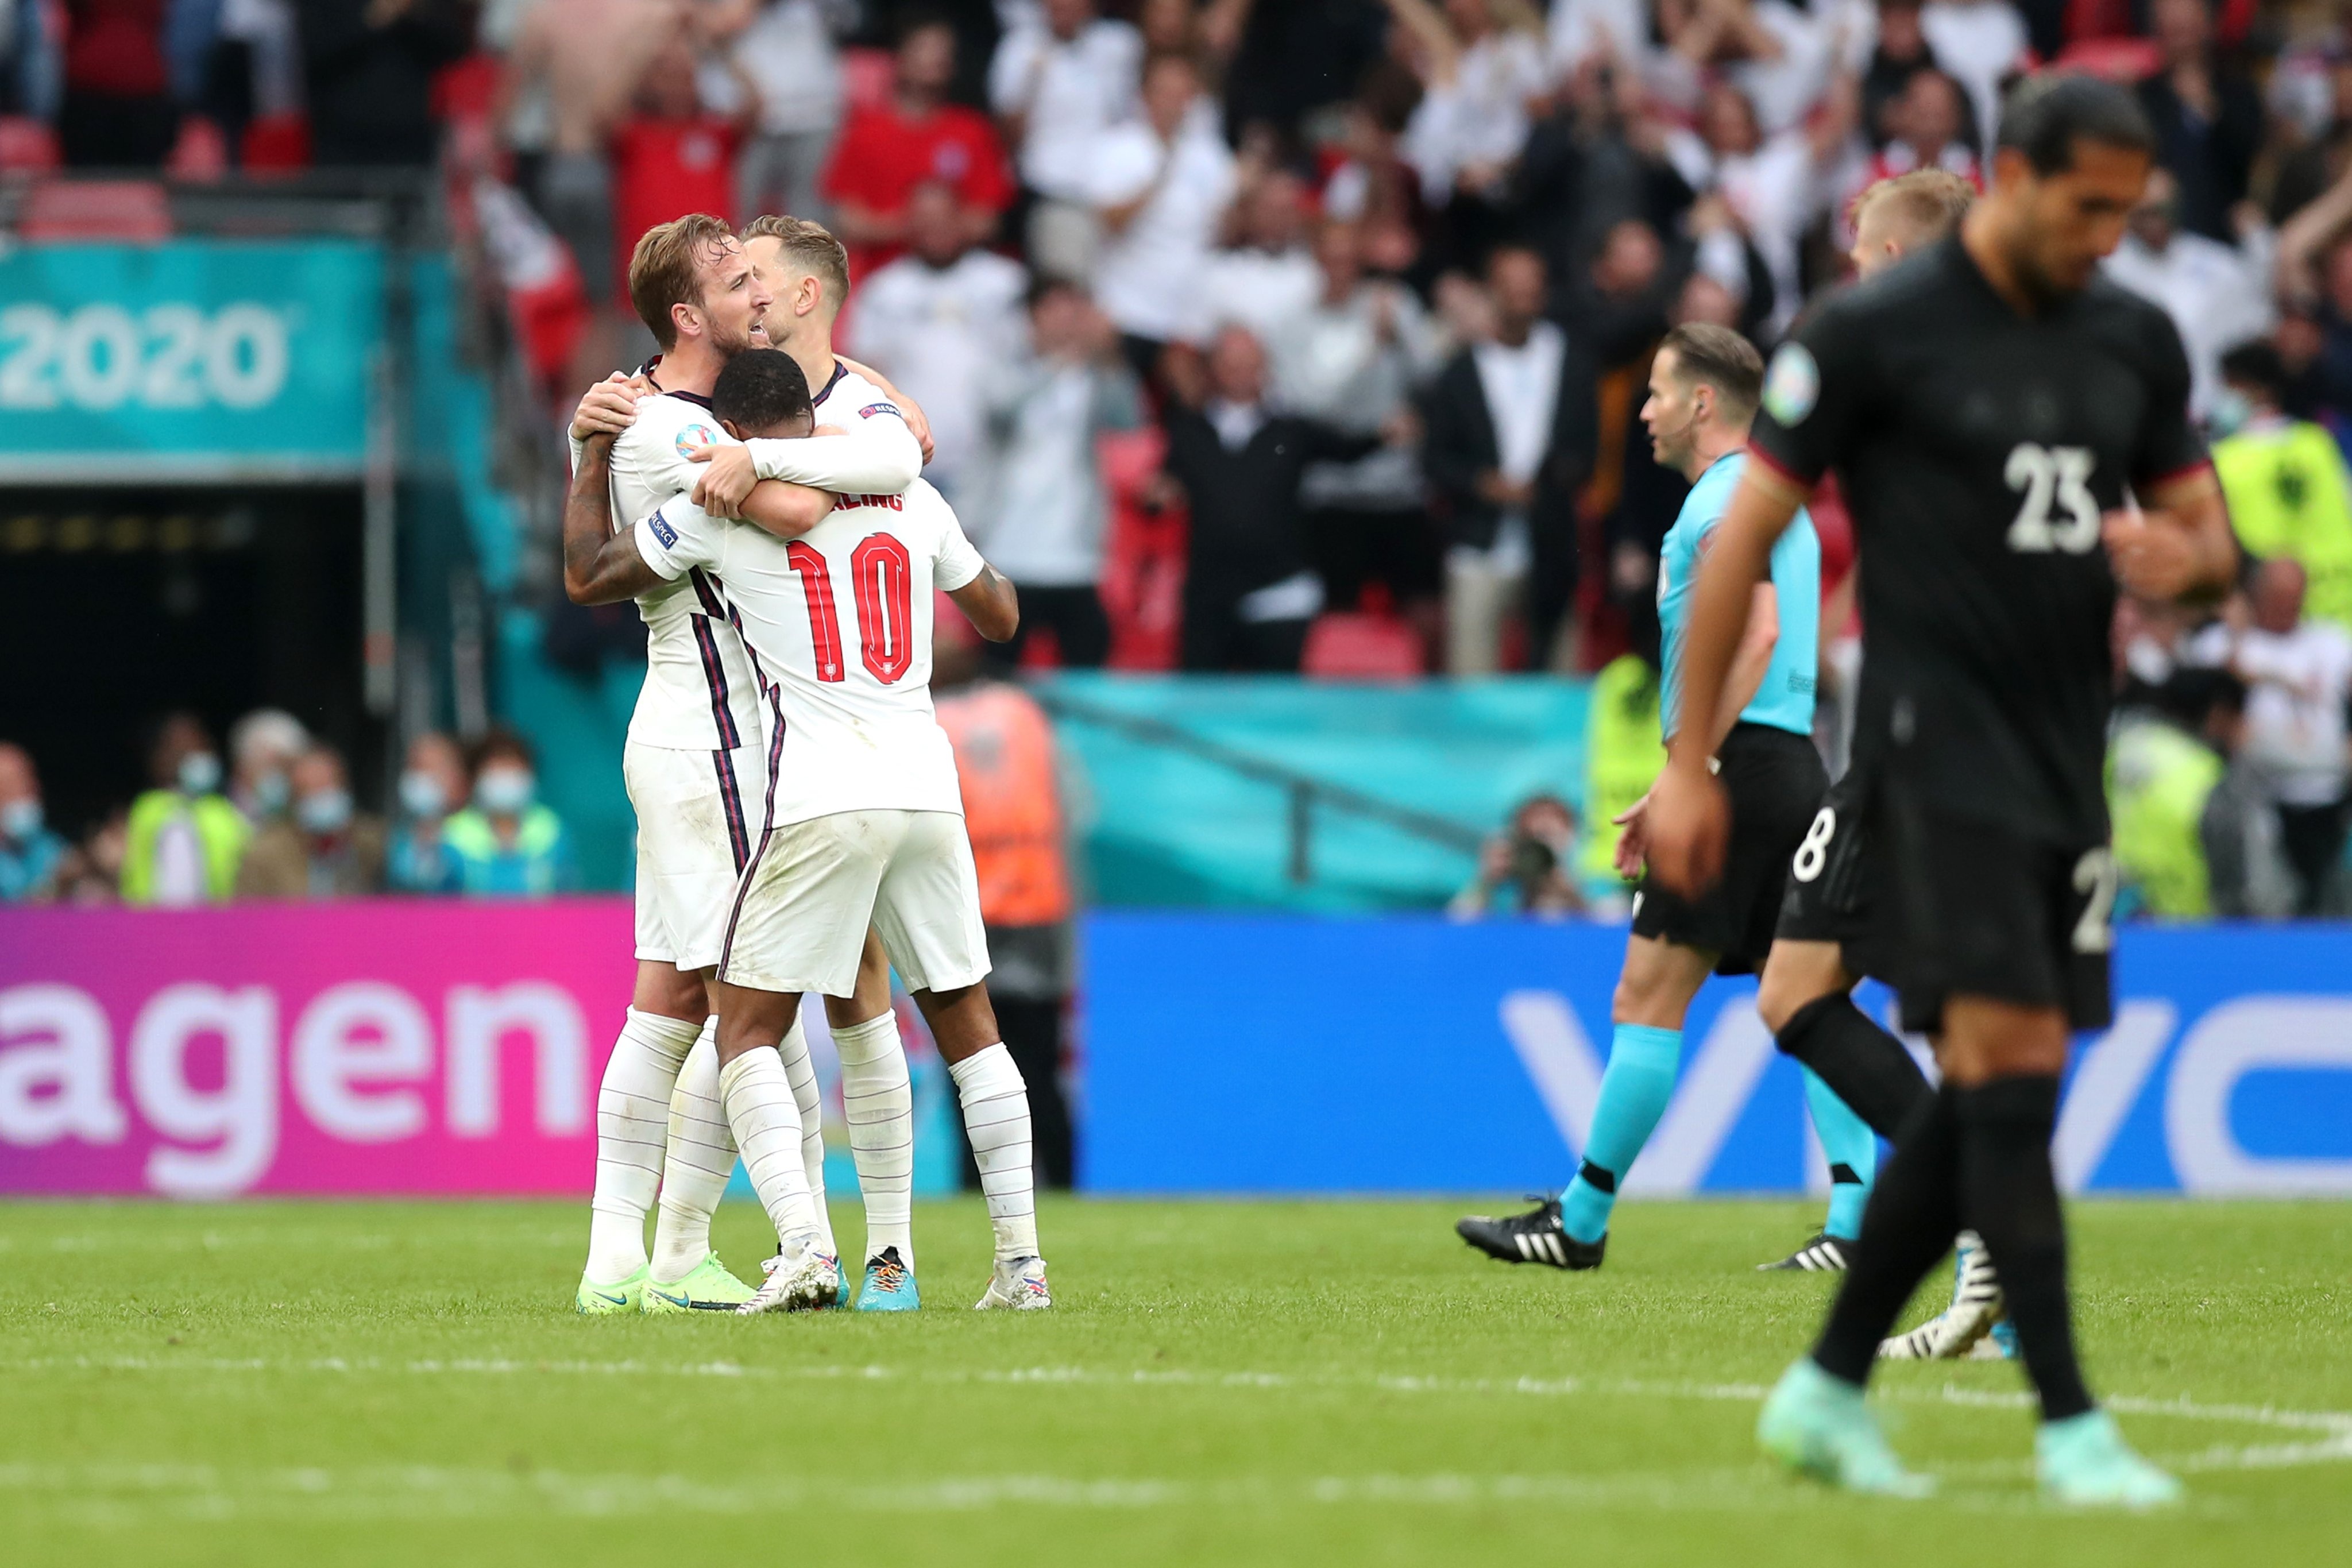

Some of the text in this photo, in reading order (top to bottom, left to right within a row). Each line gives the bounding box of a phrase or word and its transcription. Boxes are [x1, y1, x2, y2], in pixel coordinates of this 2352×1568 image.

[0, 304, 287, 409] 2020
[651, 512, 675, 546] RESPECT
[2003, 442, 2101, 555] 23
[785, 532, 912, 684] 10
[1793, 806, 1836, 883] 8
[0, 981, 588, 1196] agen
